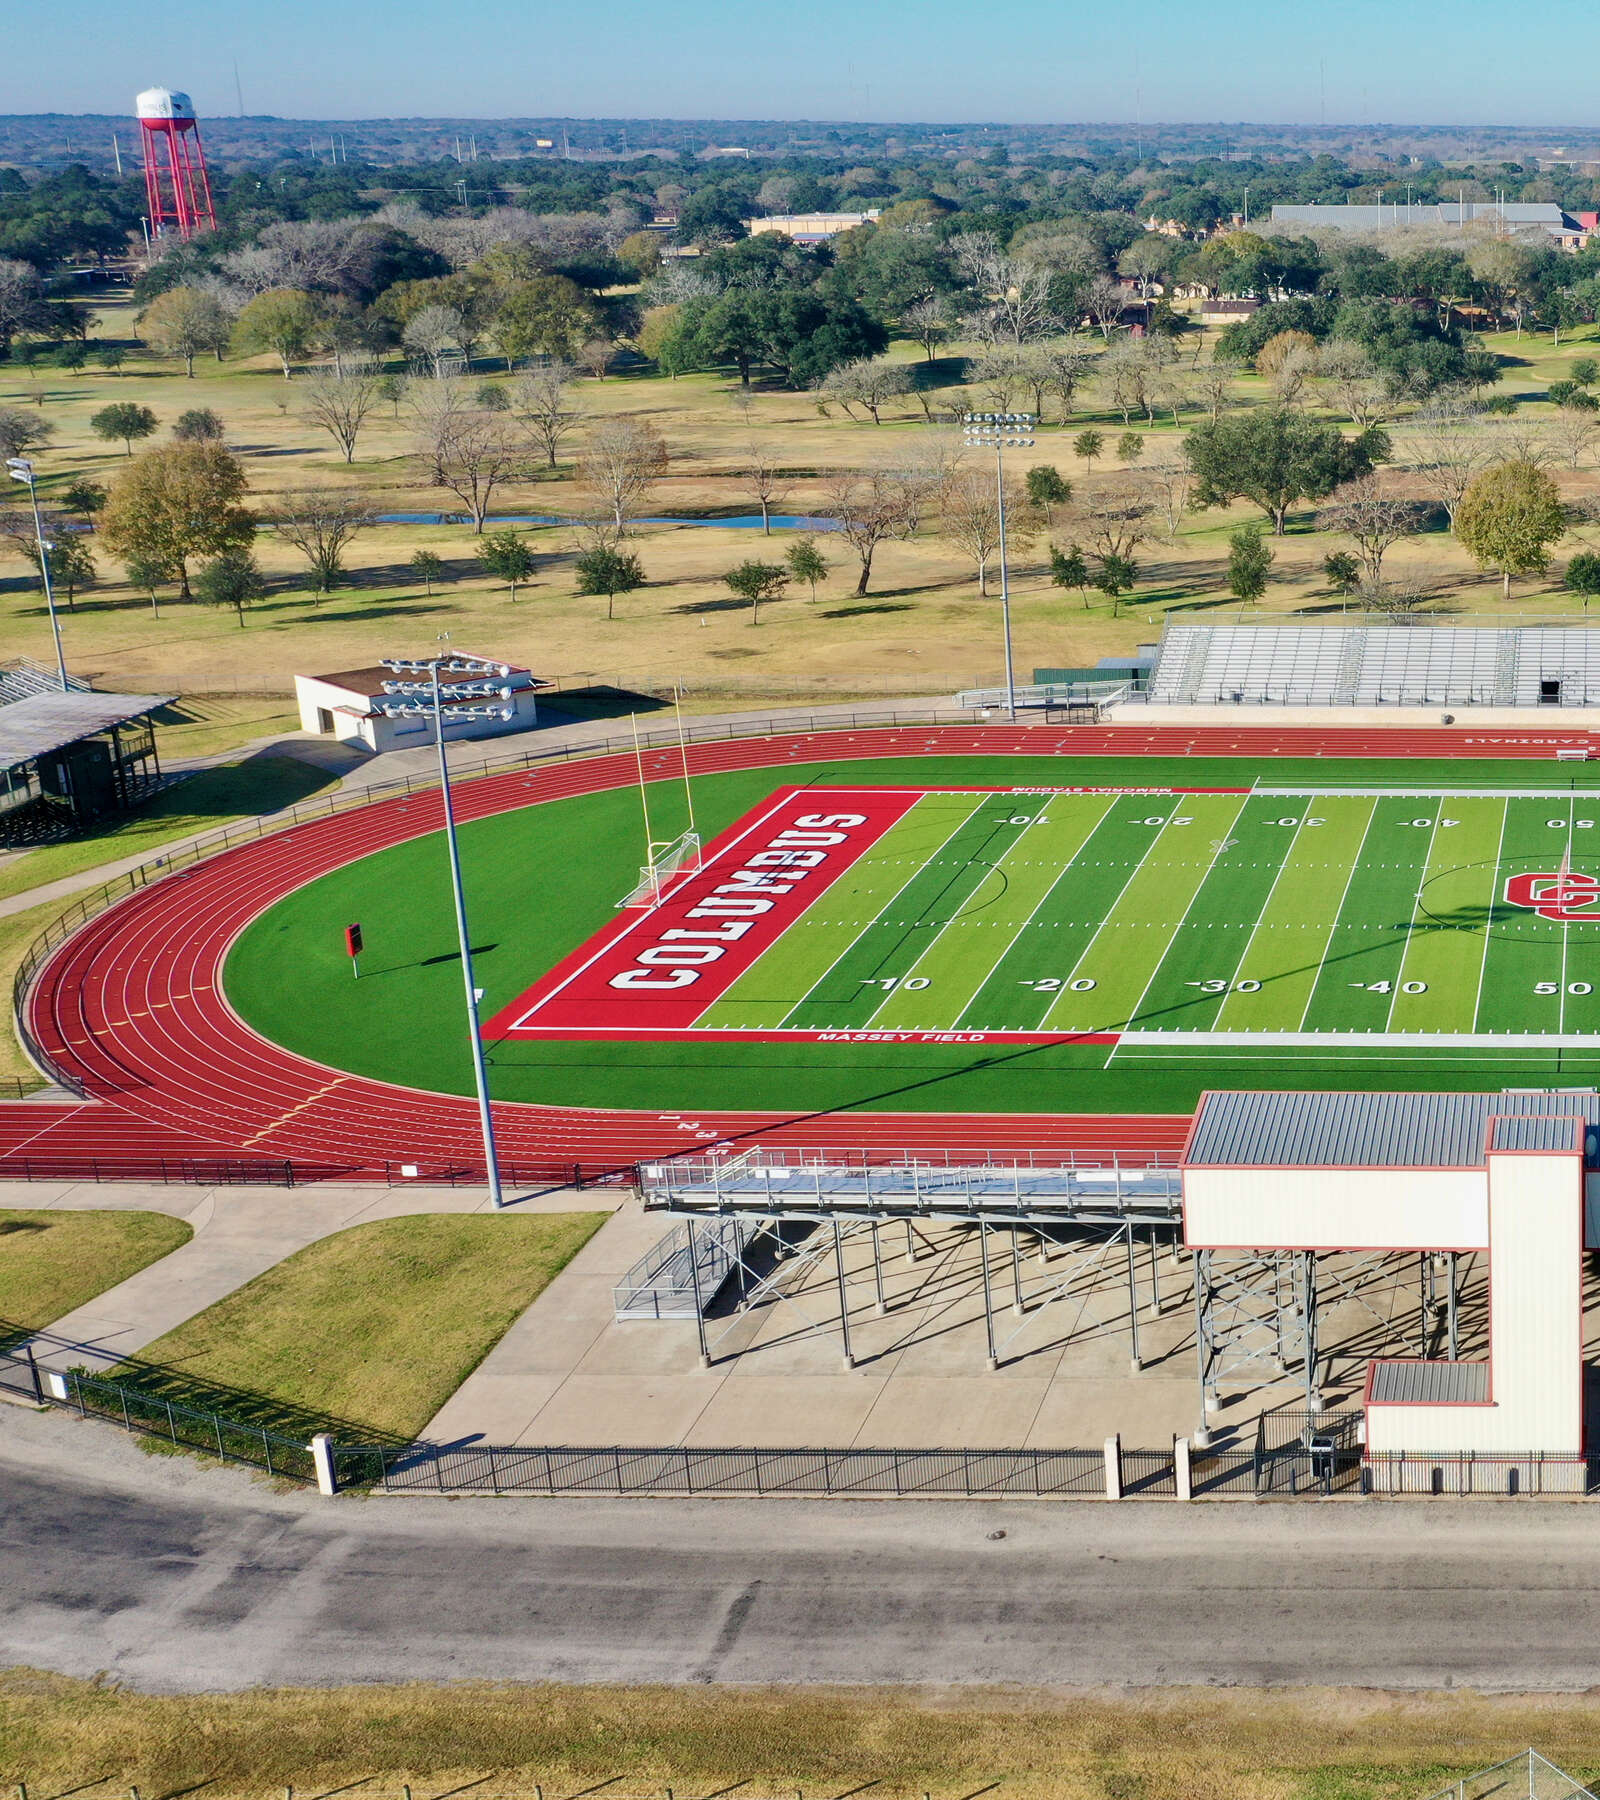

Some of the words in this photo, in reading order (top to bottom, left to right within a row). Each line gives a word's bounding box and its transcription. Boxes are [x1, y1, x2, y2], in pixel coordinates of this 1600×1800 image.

[1009, 816, 1050, 826] 10
[1143, 817, 1195, 826] 20
[1277, 817, 1326, 827] 30
[1408, 818, 1460, 828] 40
[1546, 819, 1595, 829] 50
[608, 813, 868, 990] COLUMBUS
[875, 977, 932, 991] 10
[1033, 978, 1096, 992] 20
[1200, 979, 1262, 993] 30
[1367, 980, 1428, 995] 40
[1533, 982, 1593, 995] 50
[817, 1033, 912, 1042] MASSEY
[921, 1033, 985, 1042] FIELD
